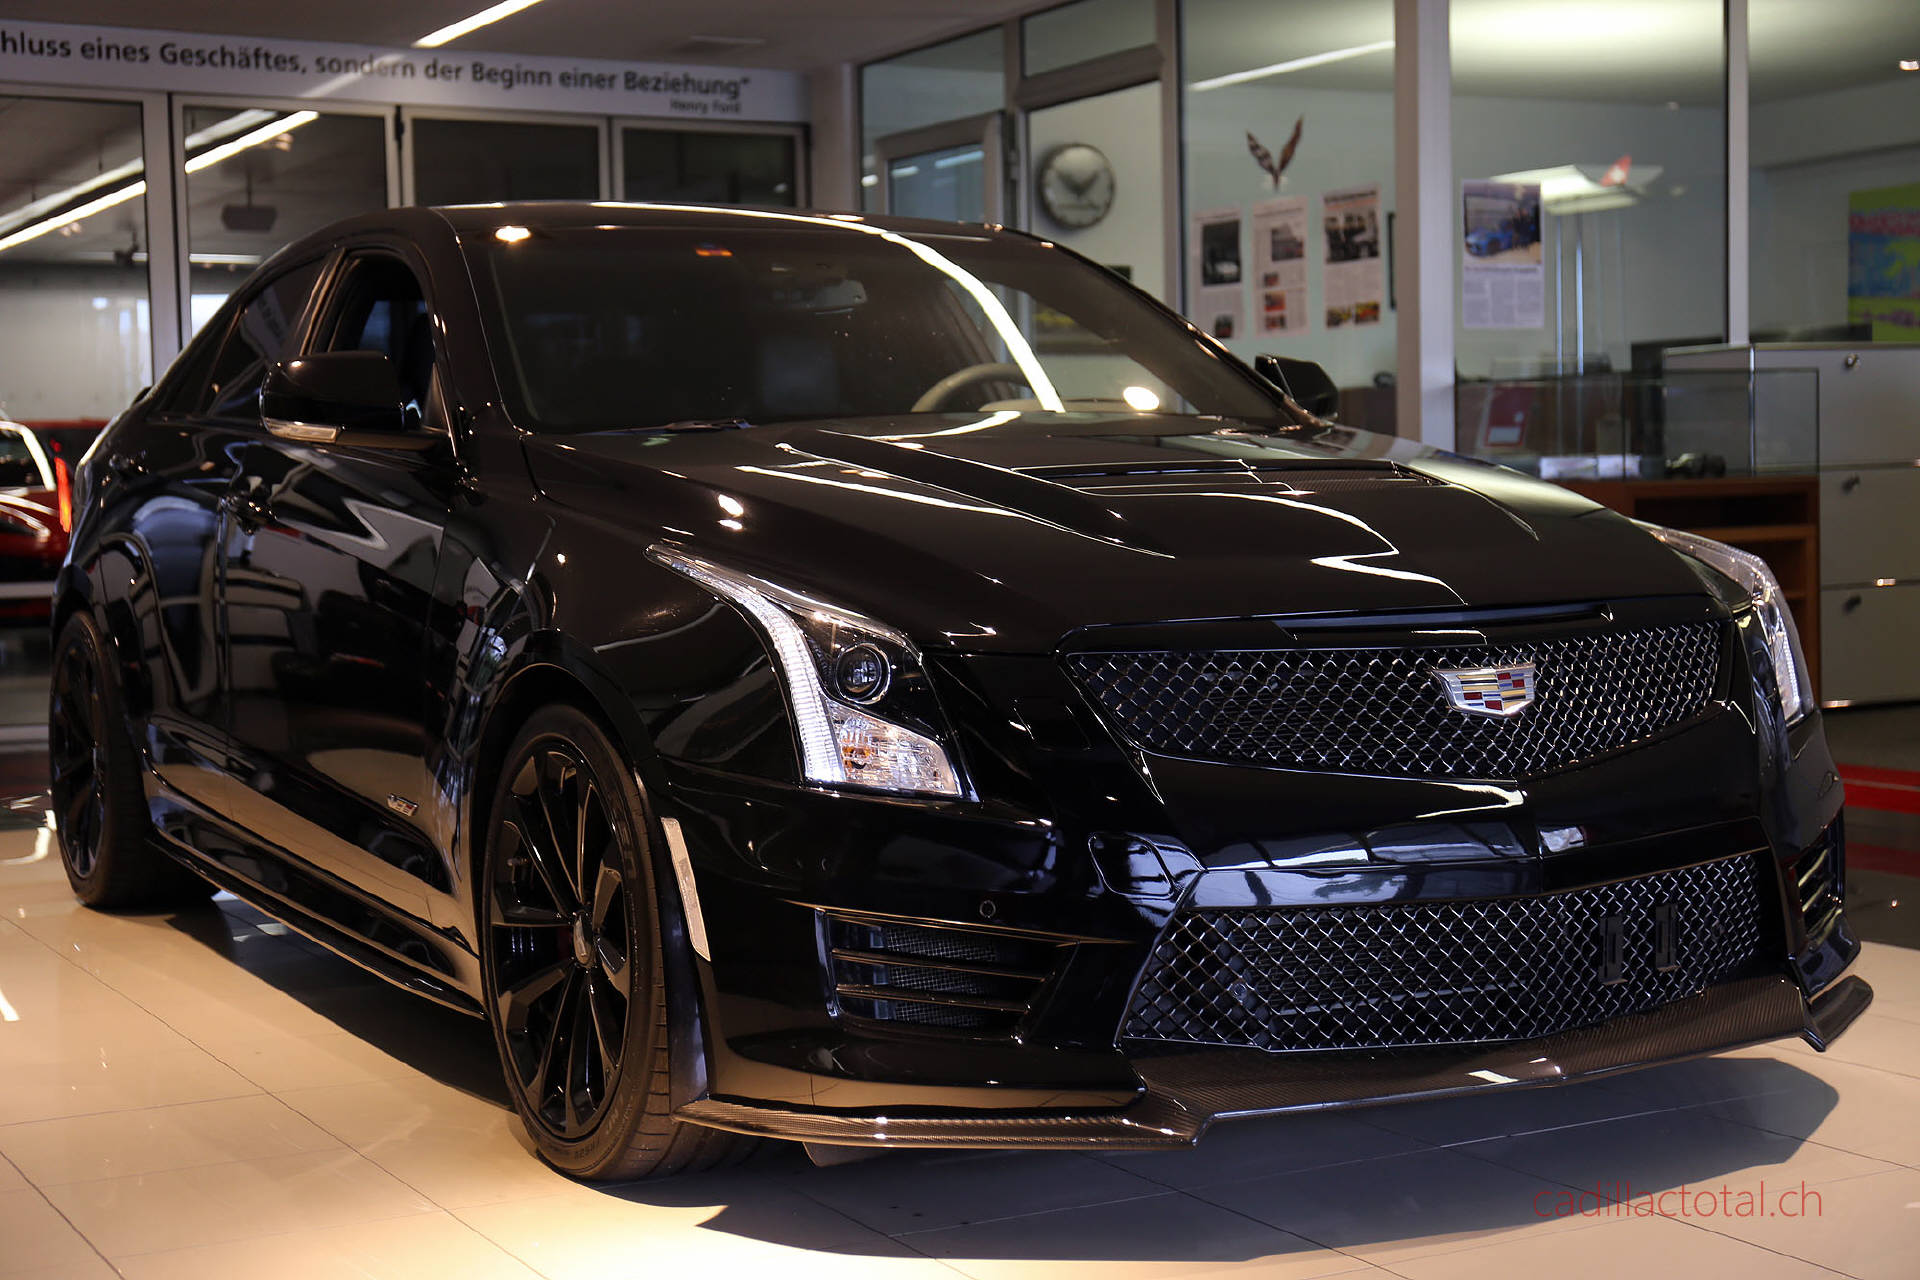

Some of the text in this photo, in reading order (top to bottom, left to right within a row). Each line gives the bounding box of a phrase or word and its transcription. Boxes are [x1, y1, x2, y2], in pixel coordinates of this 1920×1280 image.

[0, 30, 71, 58] hluss
[80, 37, 151, 63] eines
[159, 43, 307, 75] Geschäftes,
[315, 54, 417, 78] sondern
[424, 58, 463, 82] der
[472, 61, 553, 90] Beginn
[559, 67, 617, 90] einer
